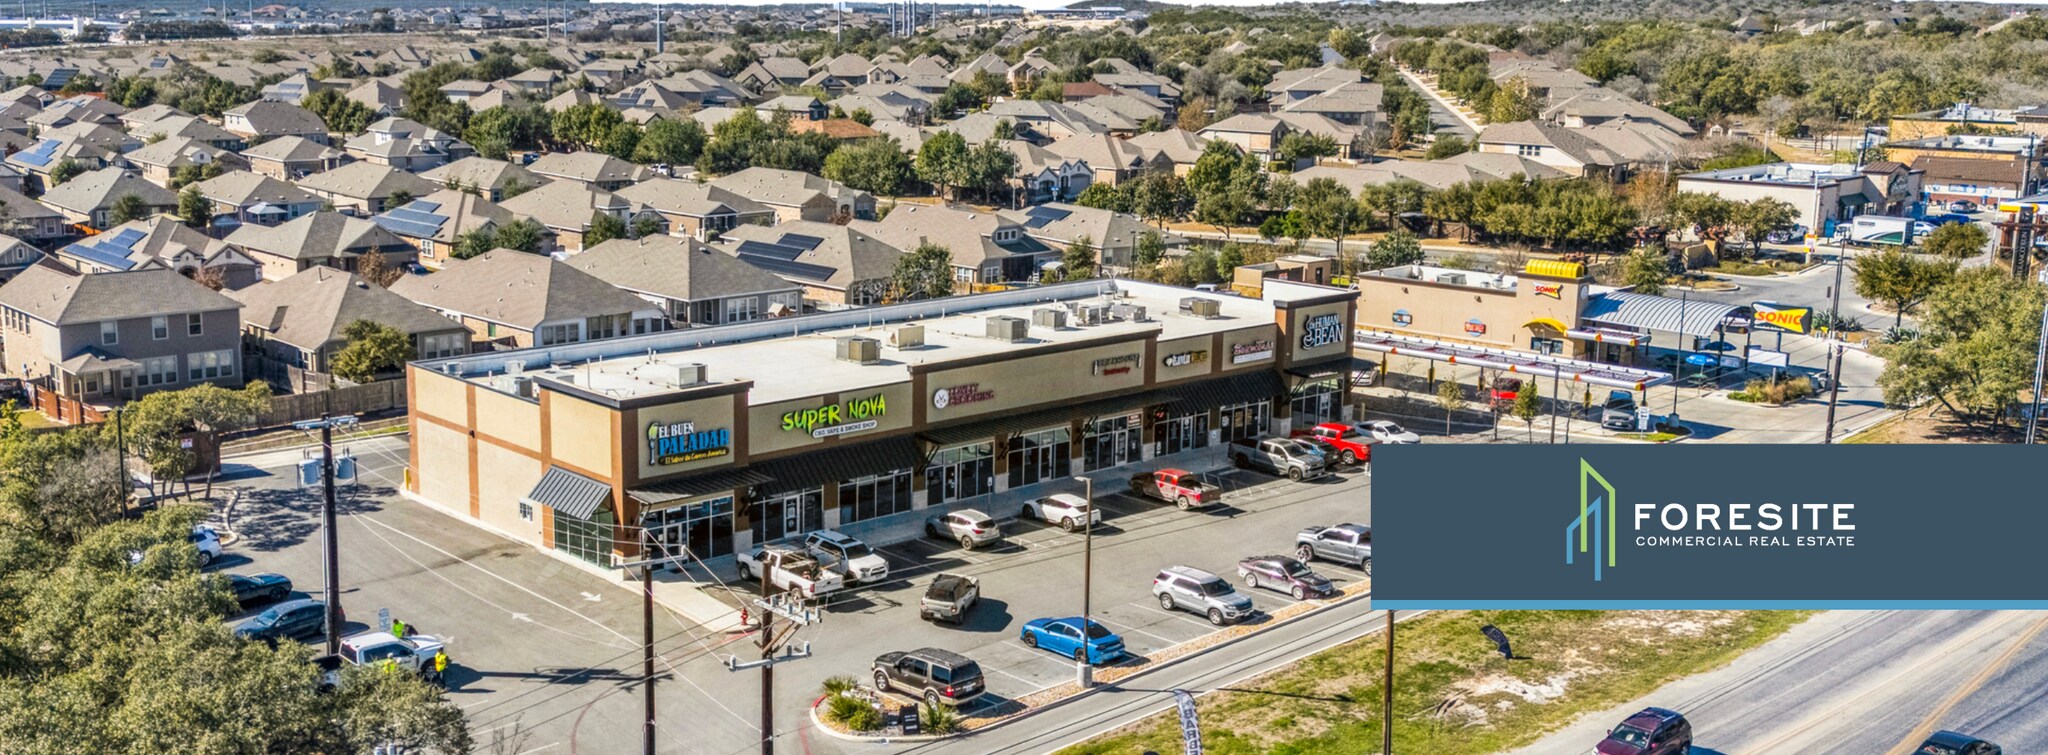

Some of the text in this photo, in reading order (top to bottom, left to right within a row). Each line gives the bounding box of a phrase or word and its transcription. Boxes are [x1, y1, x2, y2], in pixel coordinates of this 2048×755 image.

[1315, 314, 1339, 328] HUMAN
[1757, 311, 1802, 325] SONIC
[1314, 324, 1344, 346] BEAN
[782, 393, 886, 434] SUPER NOVA
[658, 421, 694, 438] EL BUEN
[827, 427, 839, 435] VAPE
[845, 423, 861, 432] SMOKE
[862, 421, 876, 429] SHOP
[659, 428, 730, 456] PALADAR
